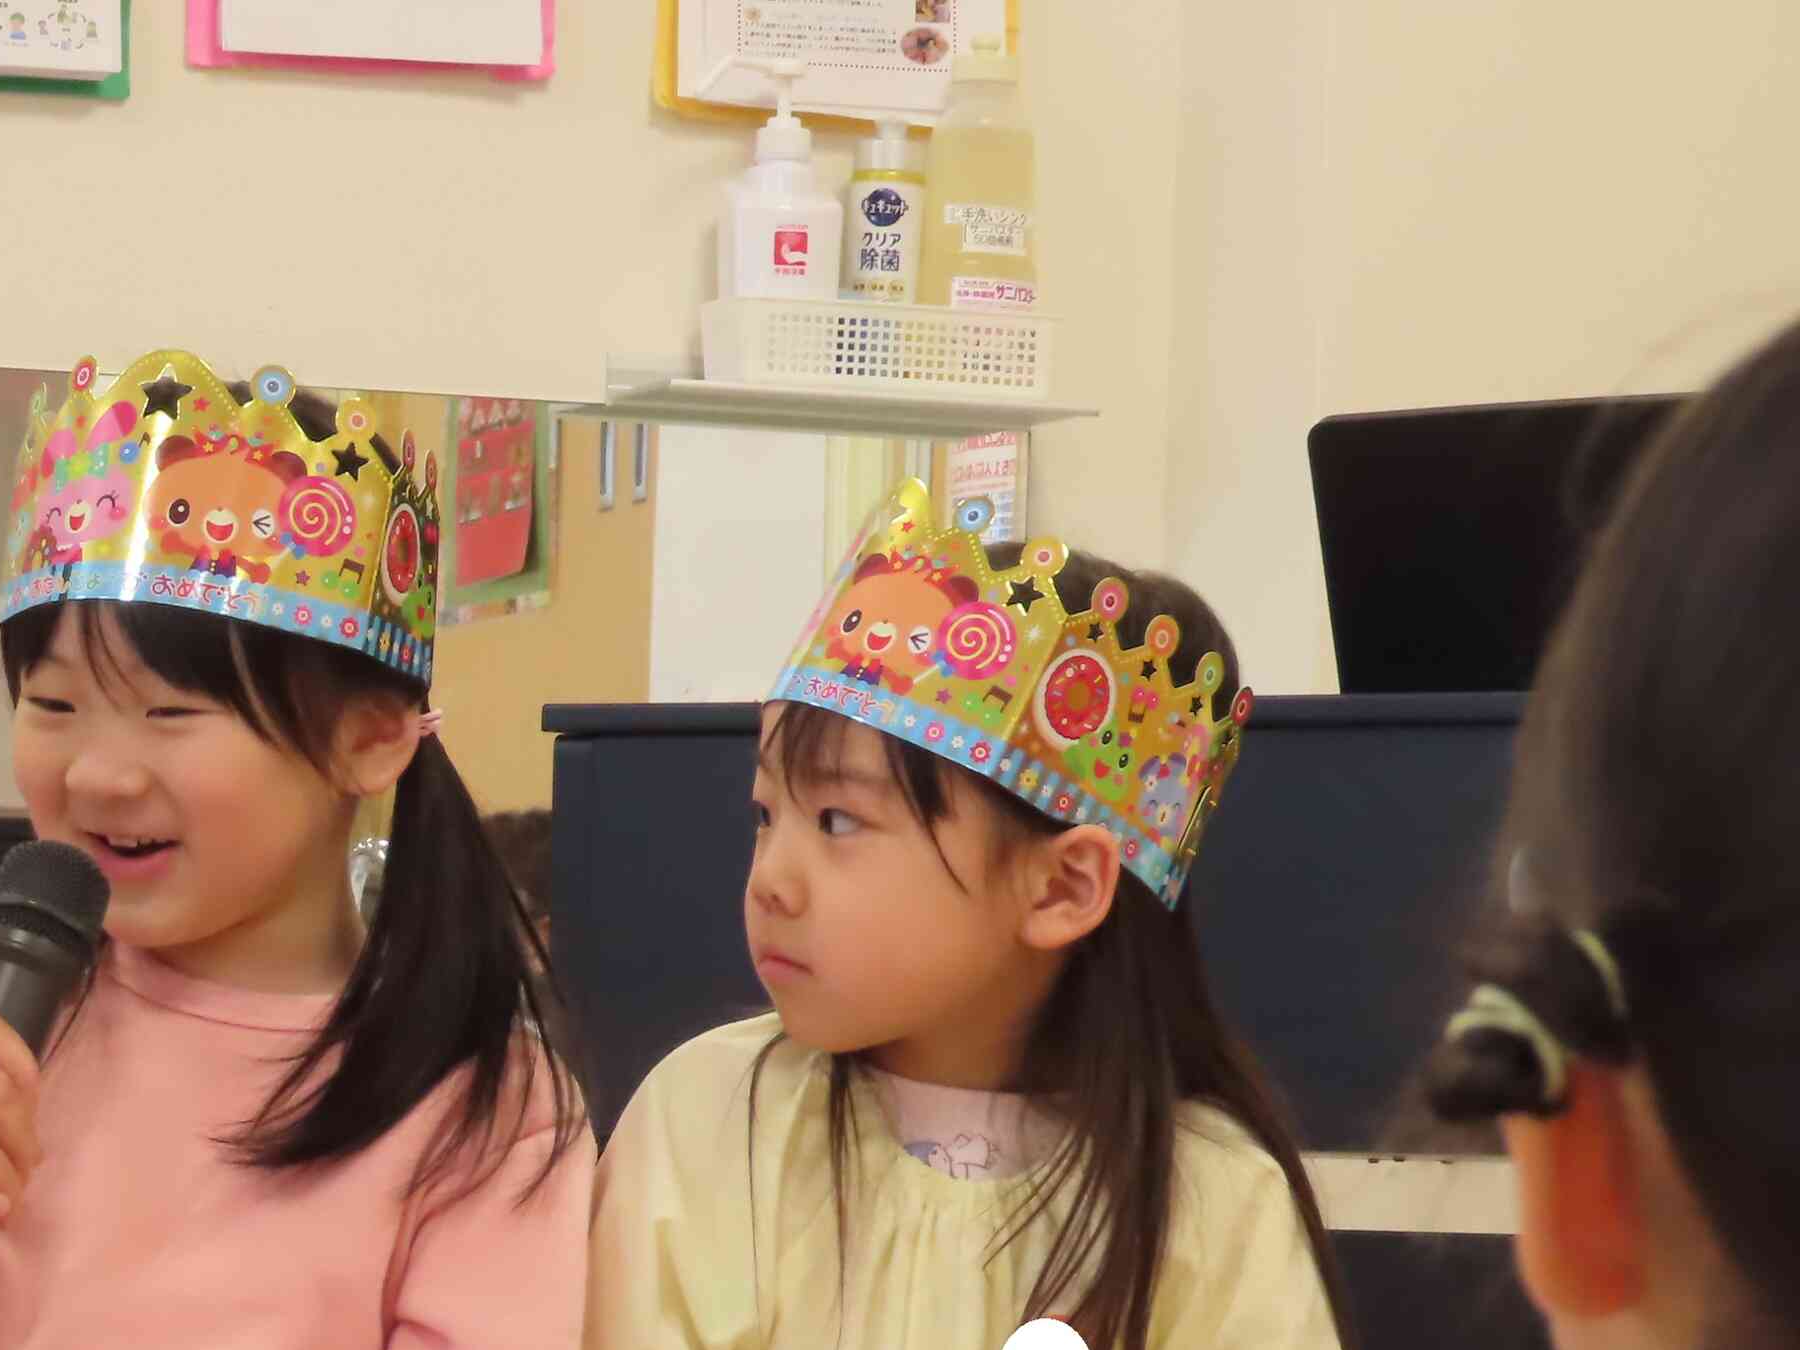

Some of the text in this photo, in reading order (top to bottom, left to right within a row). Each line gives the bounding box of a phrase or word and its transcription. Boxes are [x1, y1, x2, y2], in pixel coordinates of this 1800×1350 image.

[862, 232, 902, 248] クリア
[859, 249, 901, 272] 除菌
[152, 575, 268, 614] おめでとう
[804, 676, 896, 724] おめでとう
